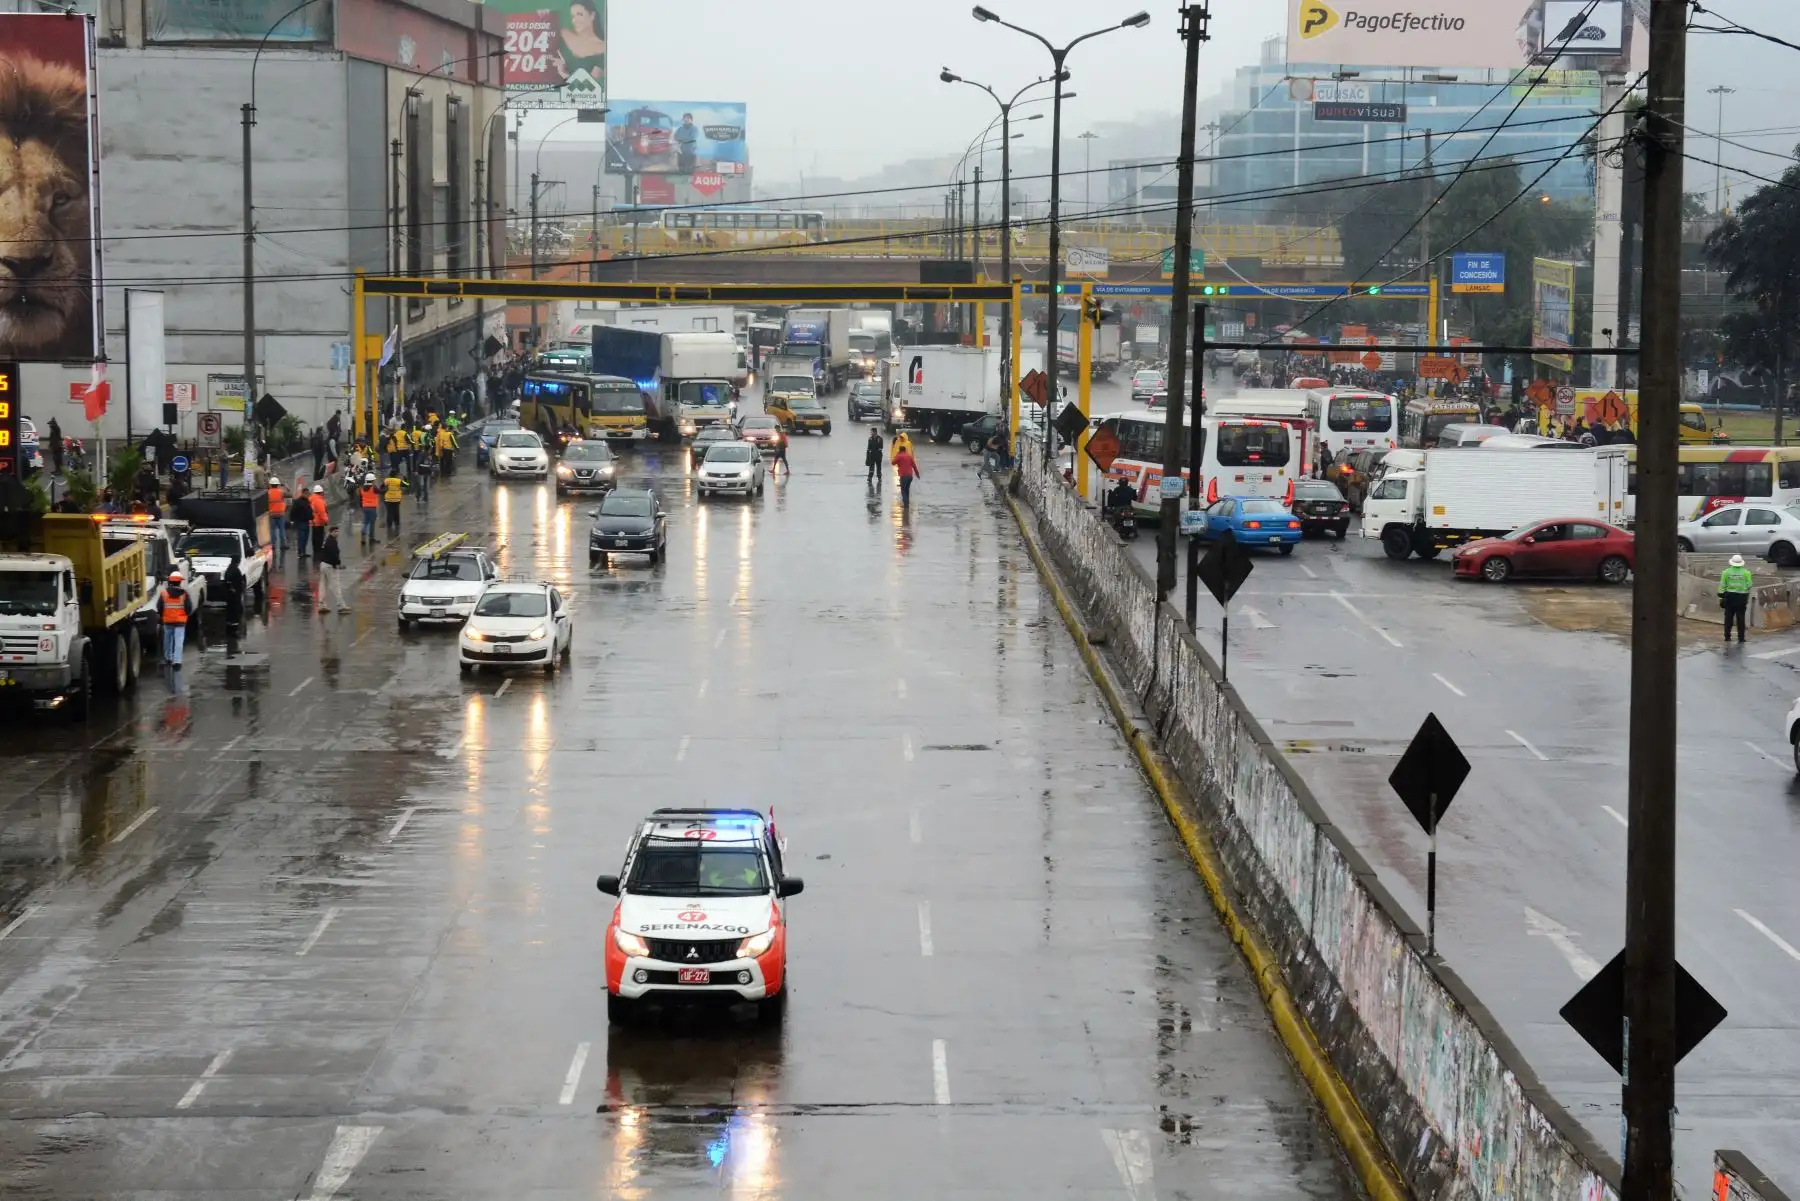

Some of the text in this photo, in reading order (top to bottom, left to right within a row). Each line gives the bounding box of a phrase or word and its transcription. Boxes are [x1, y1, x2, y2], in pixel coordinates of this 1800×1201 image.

[529, 22, 551, 30] DESDE
[1344, 11, 1465, 33] PagoEfectivo
[504, 30, 549, 52] 204
[682, 912, 702, 921] 47
[640, 923, 749, 935] SERENAZGO
